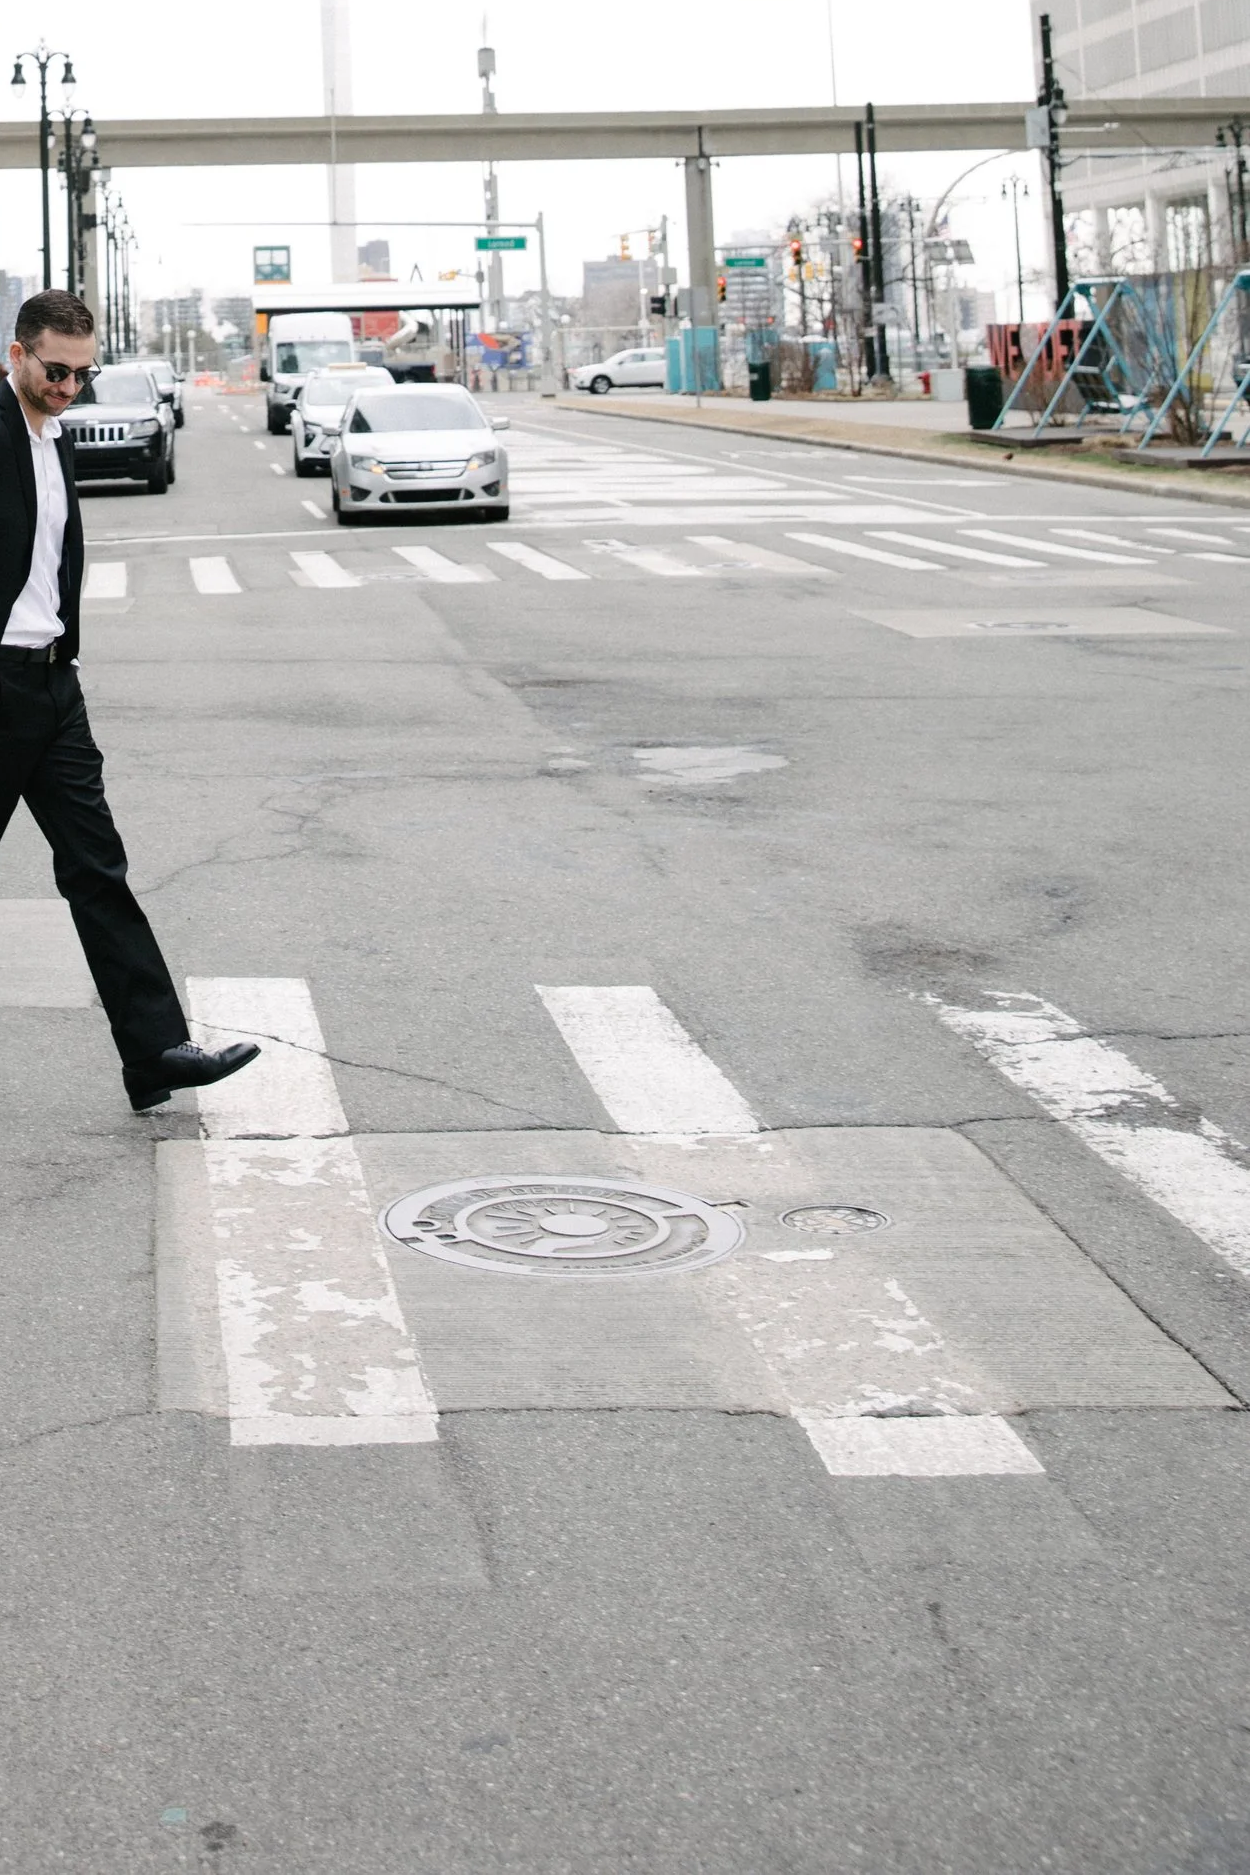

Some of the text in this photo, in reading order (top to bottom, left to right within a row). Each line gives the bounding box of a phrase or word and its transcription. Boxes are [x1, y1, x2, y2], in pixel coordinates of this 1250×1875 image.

[467, 1190, 503, 1201] OF
[507, 1185, 636, 1202] DETROIT
[491, 1199, 561, 1213] WATER
